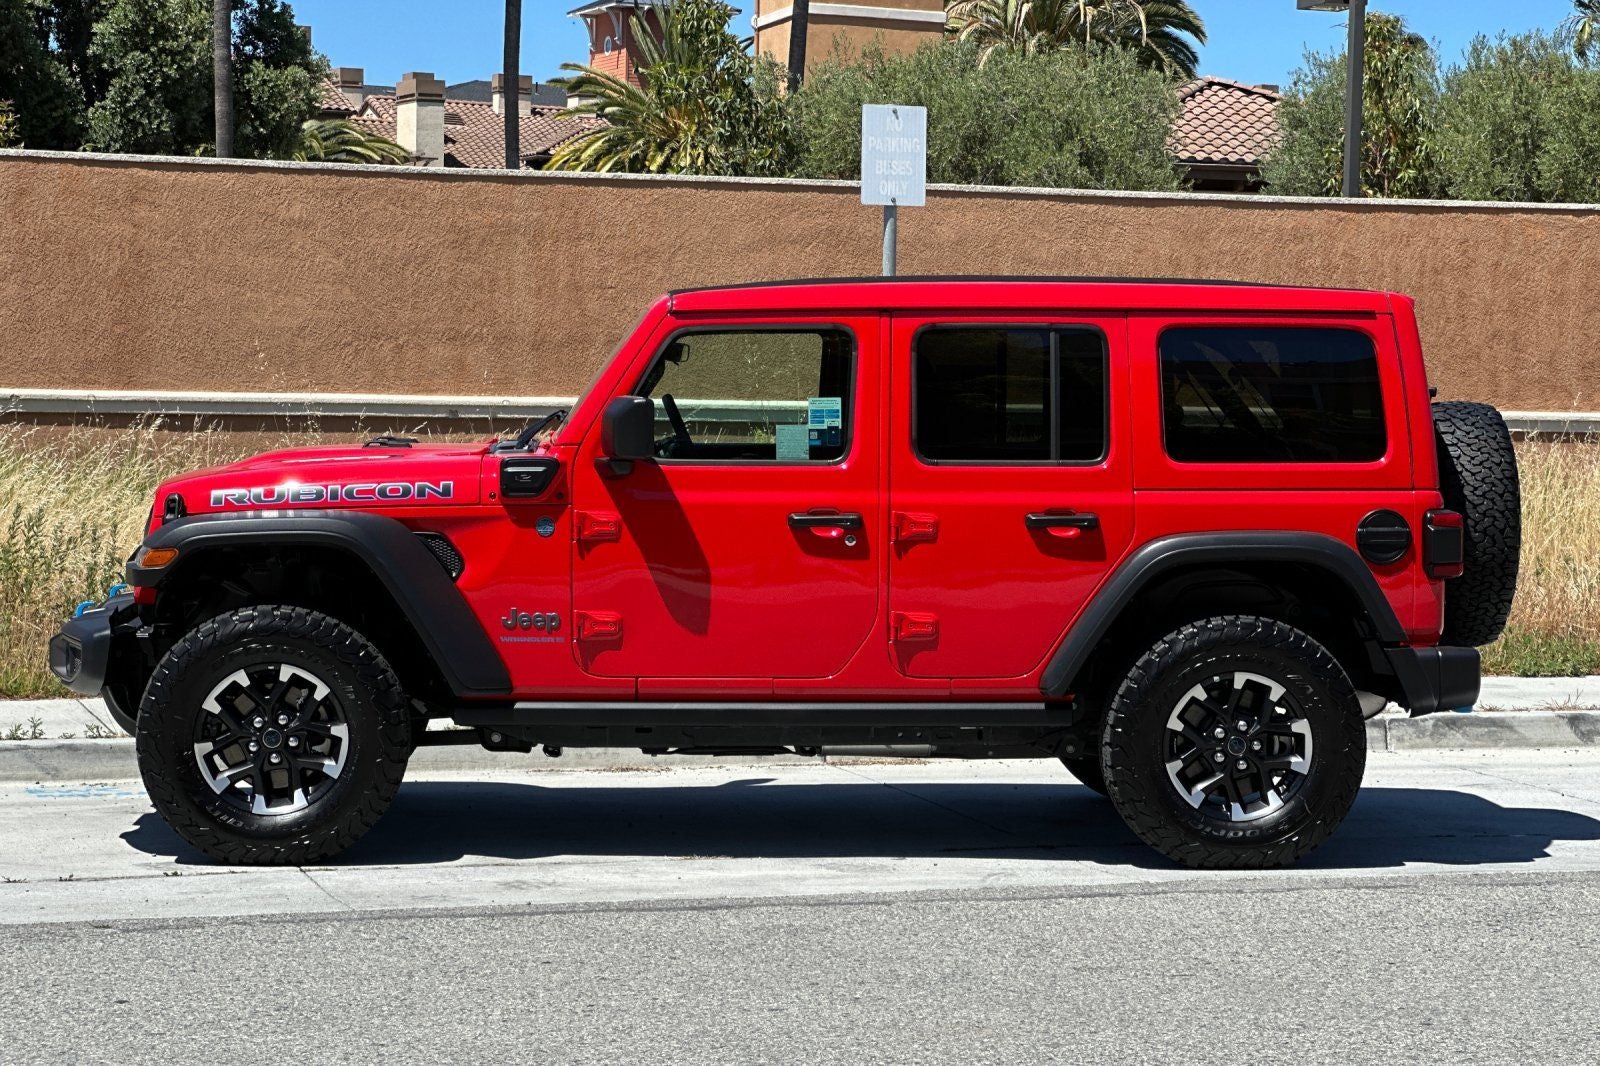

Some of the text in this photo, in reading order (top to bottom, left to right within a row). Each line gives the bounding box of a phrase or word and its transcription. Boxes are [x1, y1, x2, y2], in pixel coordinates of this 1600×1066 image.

[868, 135, 920, 153] PARKING
[879, 180, 909, 196] ONLY
[210, 480, 454, 507] RUBICON
[501, 607, 561, 634] Jeep
